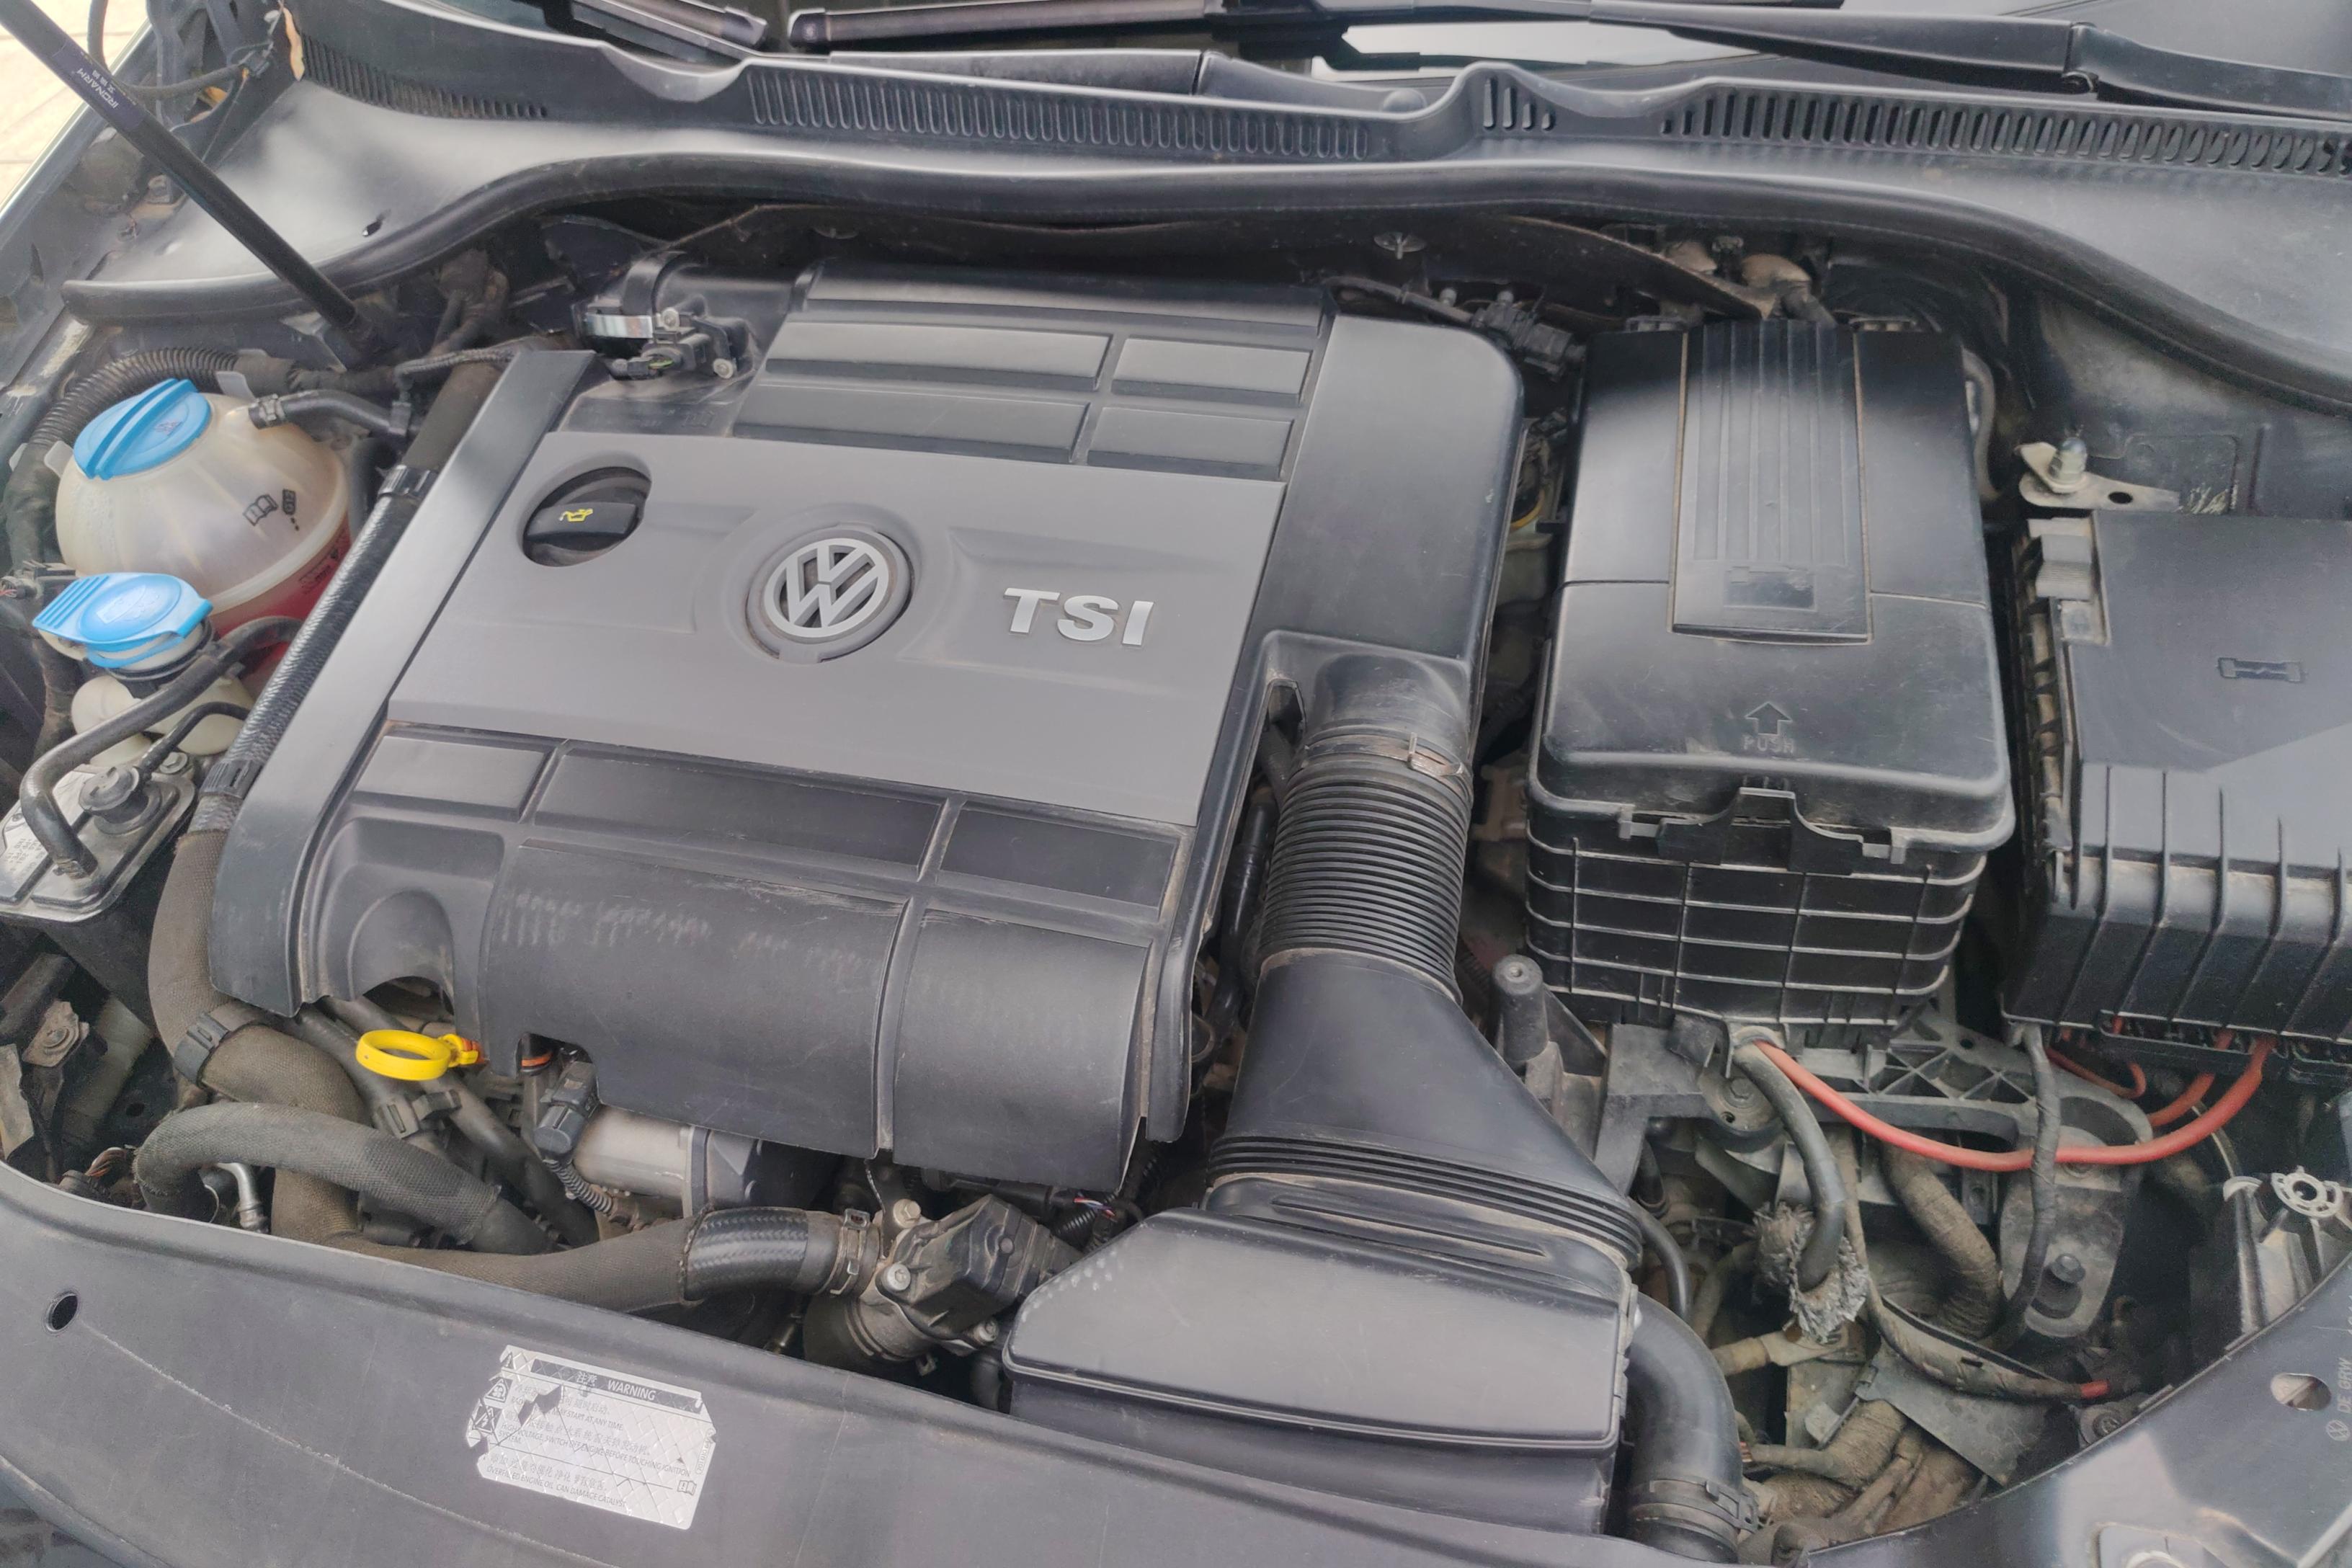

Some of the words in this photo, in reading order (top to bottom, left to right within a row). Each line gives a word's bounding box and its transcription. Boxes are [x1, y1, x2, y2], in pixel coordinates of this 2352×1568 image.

[76, 68, 119, 109] IRONARM
[1004, 588, 1155, 647] TSI
[1743, 734, 1795, 754] PUSH
[606, 1378, 656, 1402] WARNING
[566, 1409, 584, 1422] START
[518, 1474, 544, 1487] ENGINE
[555, 1483, 570, 1494] CAN
[569, 1486, 598, 1501] DAMAGE
